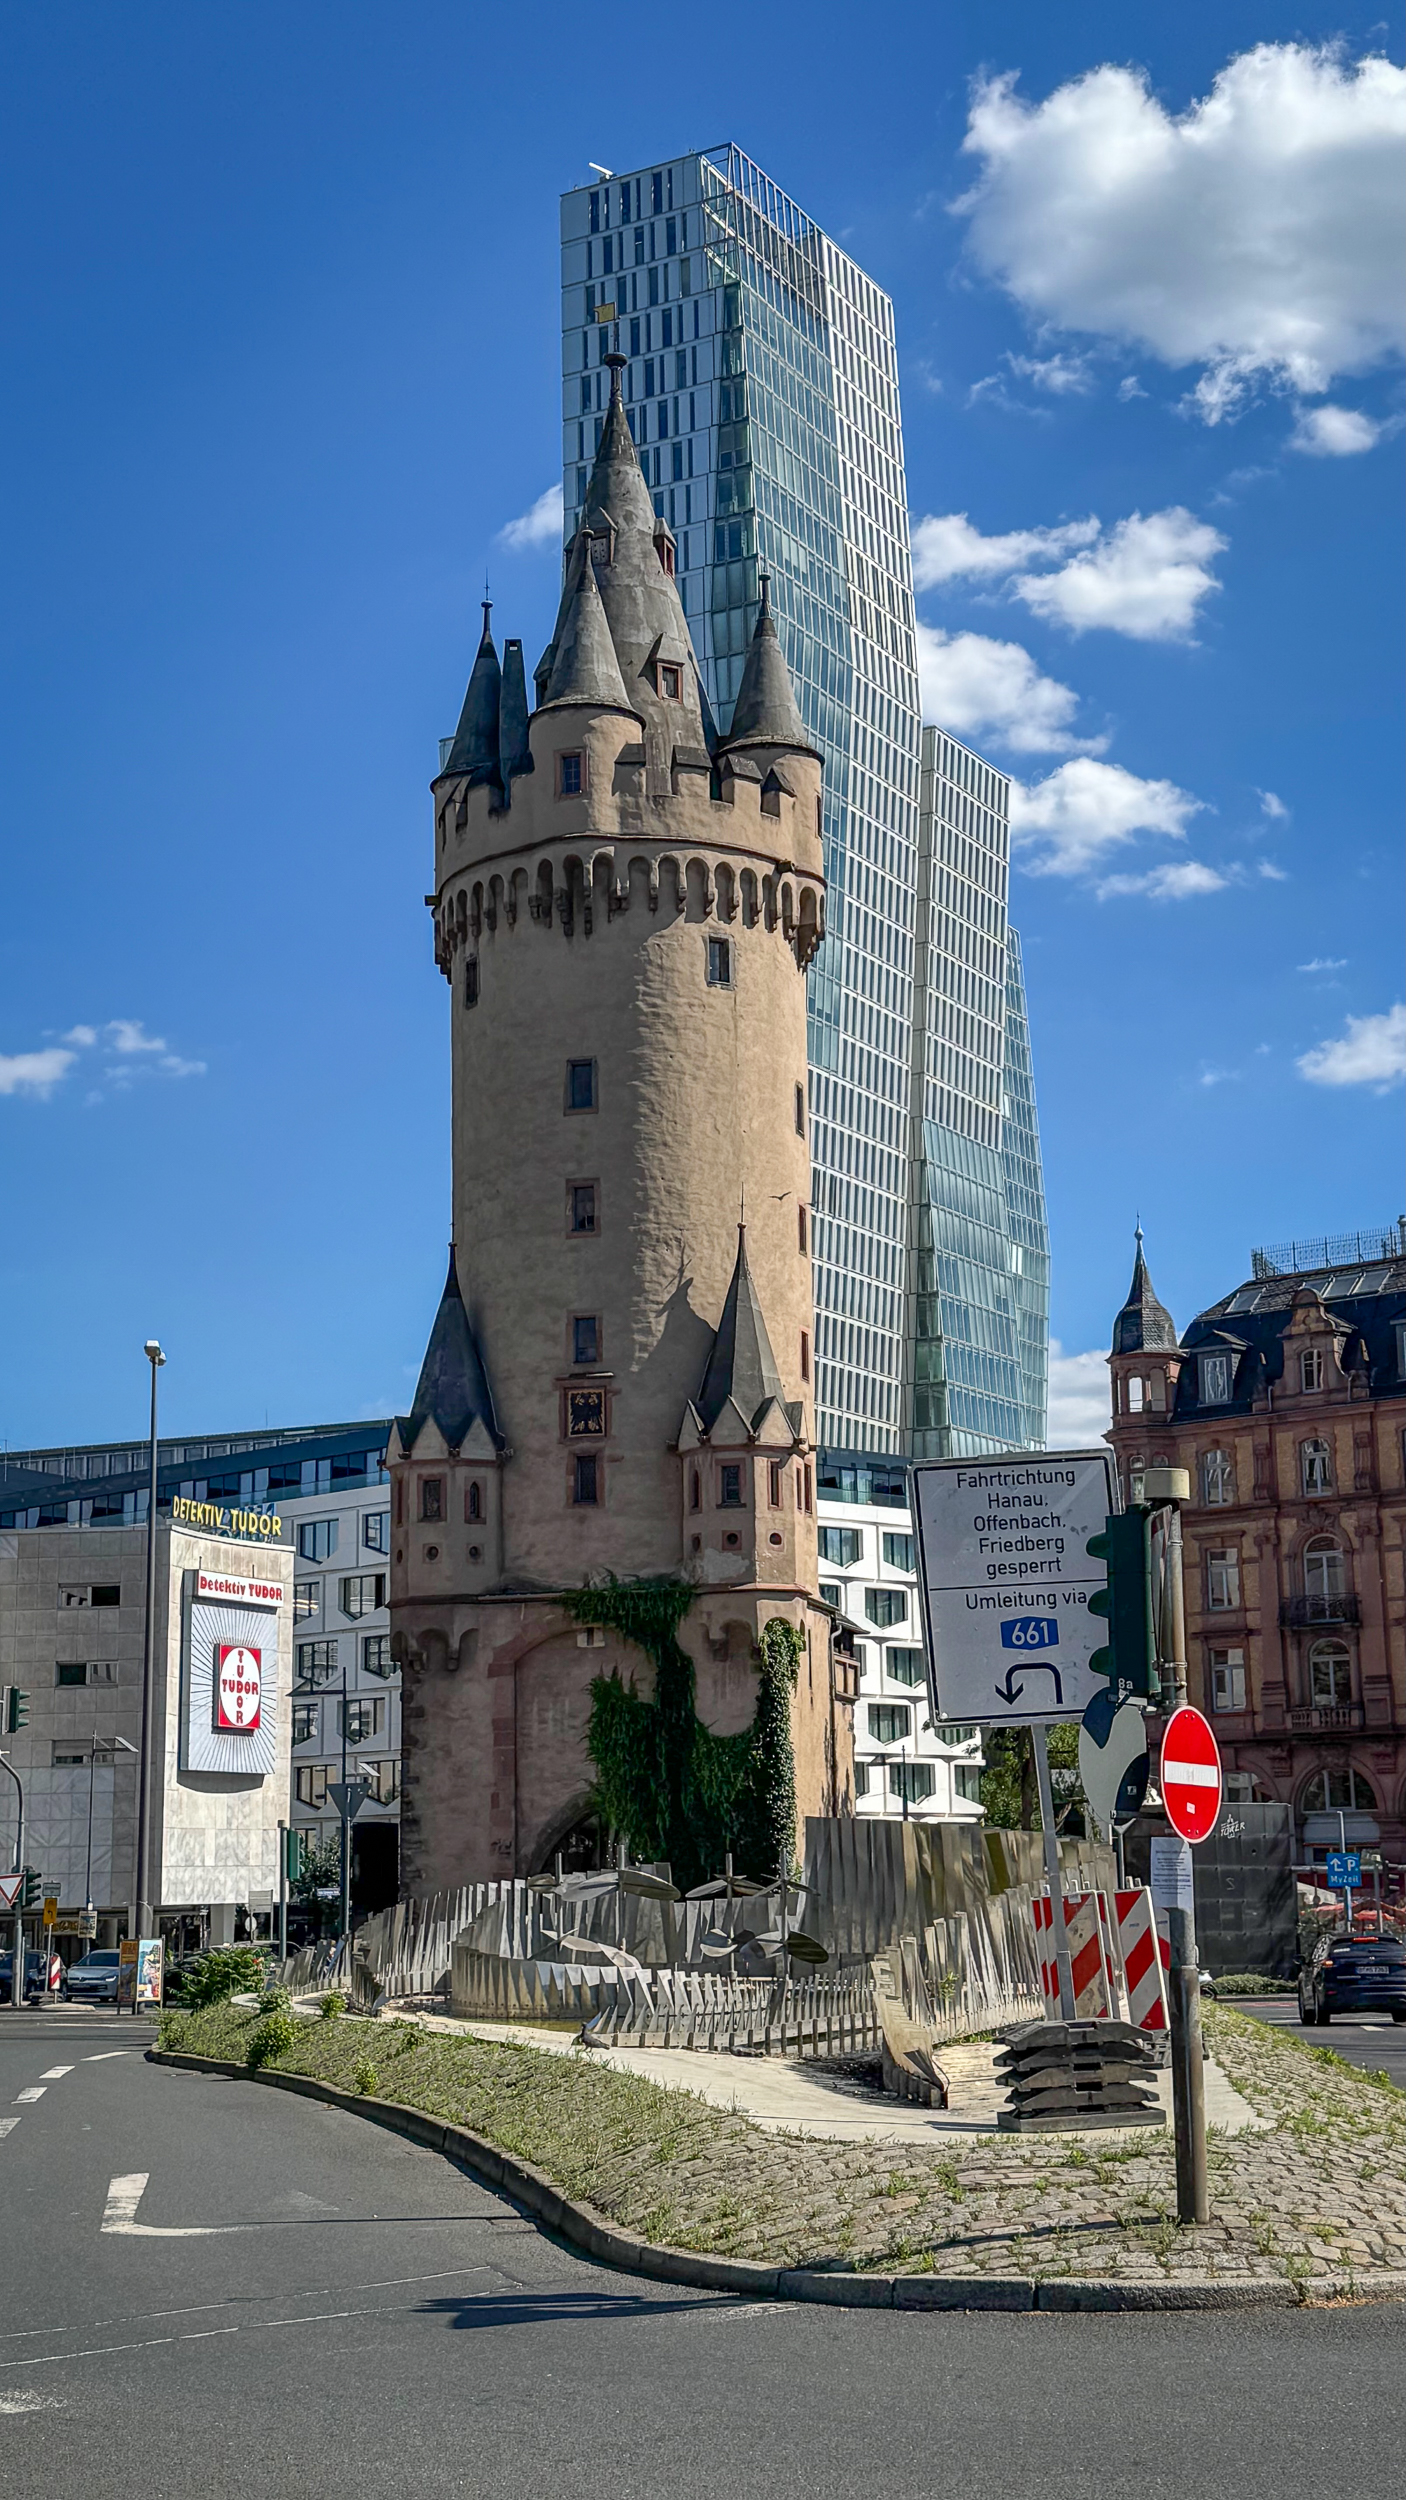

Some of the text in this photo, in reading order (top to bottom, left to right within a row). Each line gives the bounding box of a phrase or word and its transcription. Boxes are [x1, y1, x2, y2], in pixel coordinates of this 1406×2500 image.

[956, 1469, 1075, 1488] Fahrtrichtung
[987, 1492, 1048, 1509] Hanau,
[173, 1495, 282, 1537] DETEKTIV TUDOR
[974, 1511, 1066, 1531] Offenbach,
[979, 1535, 1065, 1554] Friedberg
[986, 1557, 1062, 1580] gesperrt
[200, 1575, 283, 1601] Detektiv TUDOR
[966, 1588, 1087, 1610] Umleitung via
[1011, 1621, 1049, 1646] 661
[222, 1679, 259, 1695] TUDOR
[236, 1649, 244, 1724] TUDOR
[1118, 1677, 1133, 1689] 8a
[1330, 1875, 1359, 1884] MyZeil
